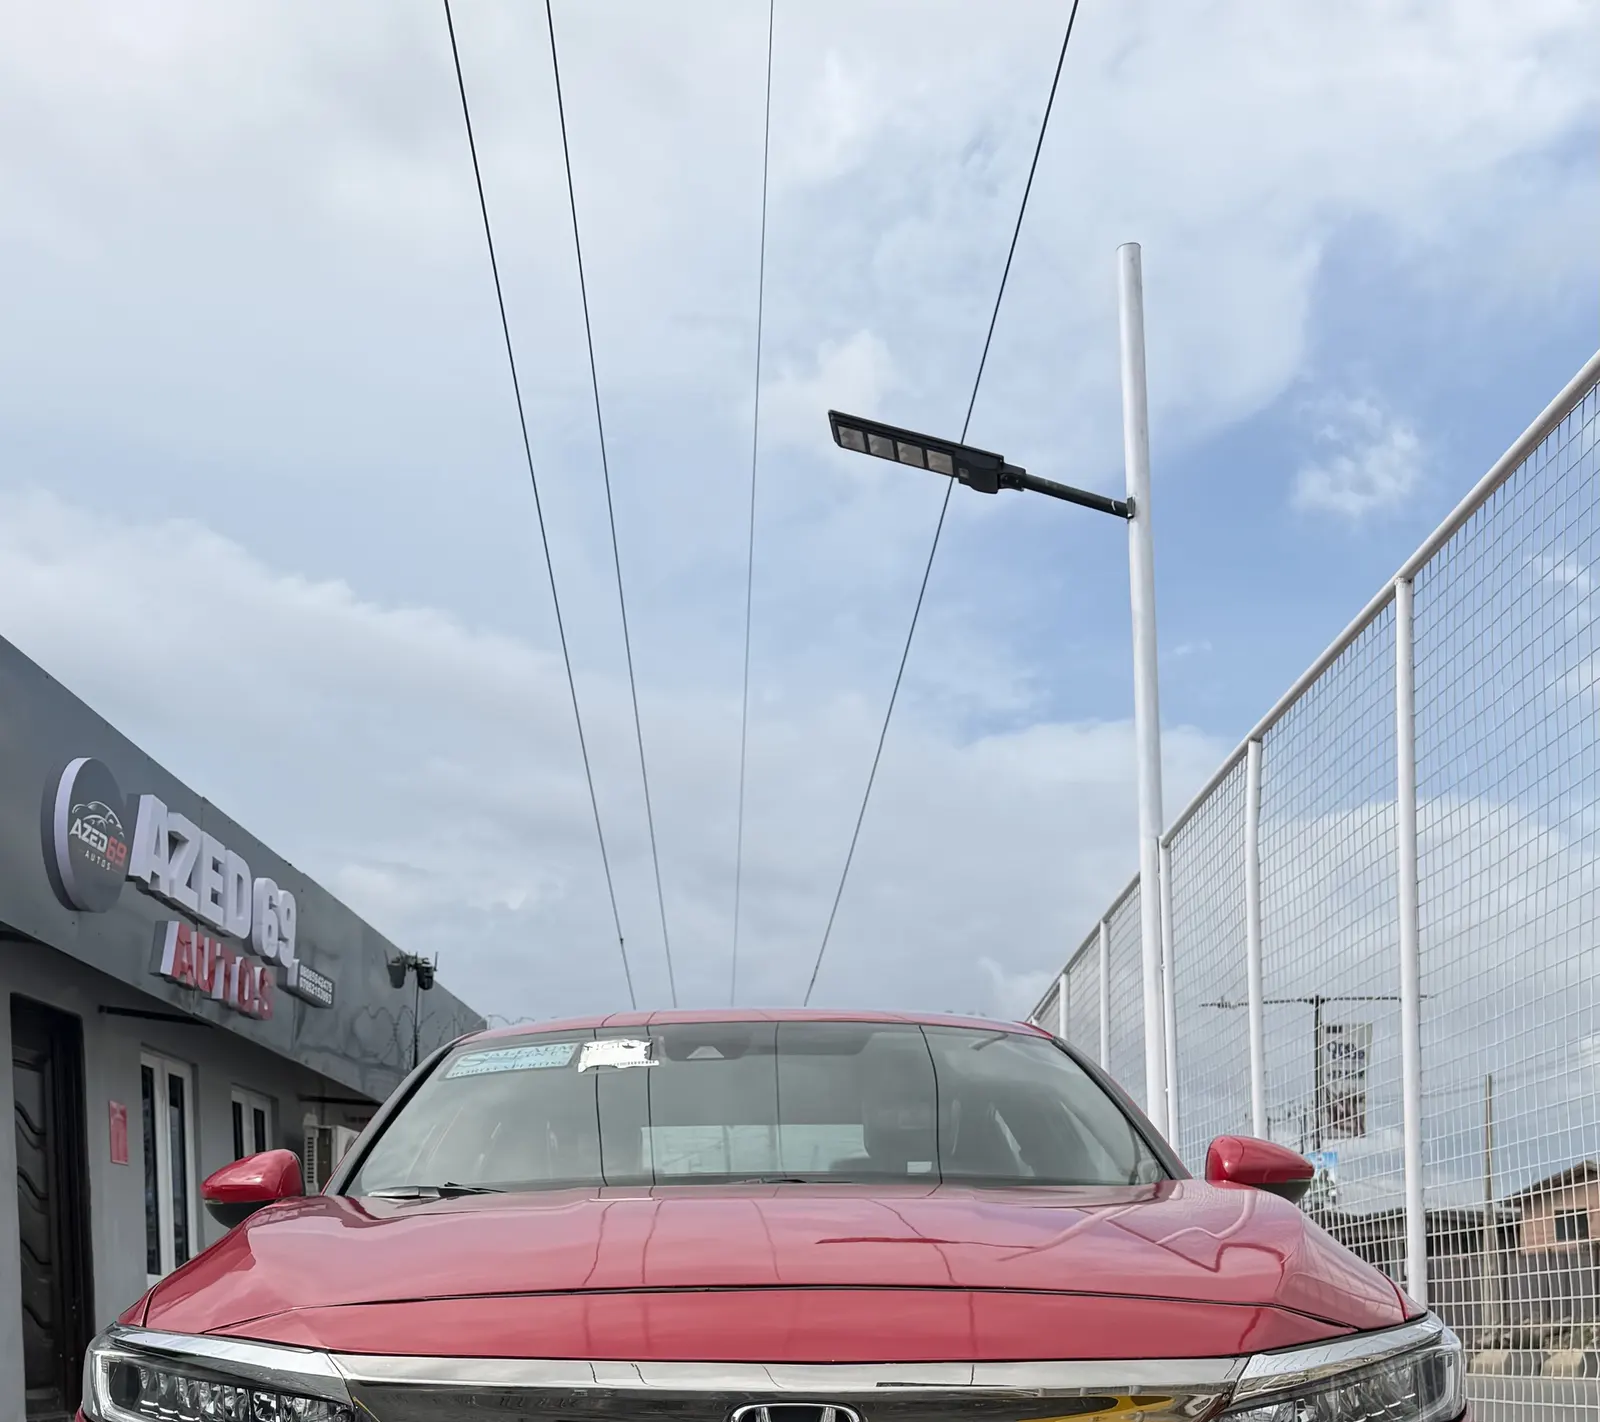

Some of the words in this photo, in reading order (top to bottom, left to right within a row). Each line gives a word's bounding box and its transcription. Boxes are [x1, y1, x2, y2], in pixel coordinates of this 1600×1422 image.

[69, 818, 127, 867] AZED69
[85, 849, 111, 871] AUTOS
[160, 920, 273, 1020] AUTOS
